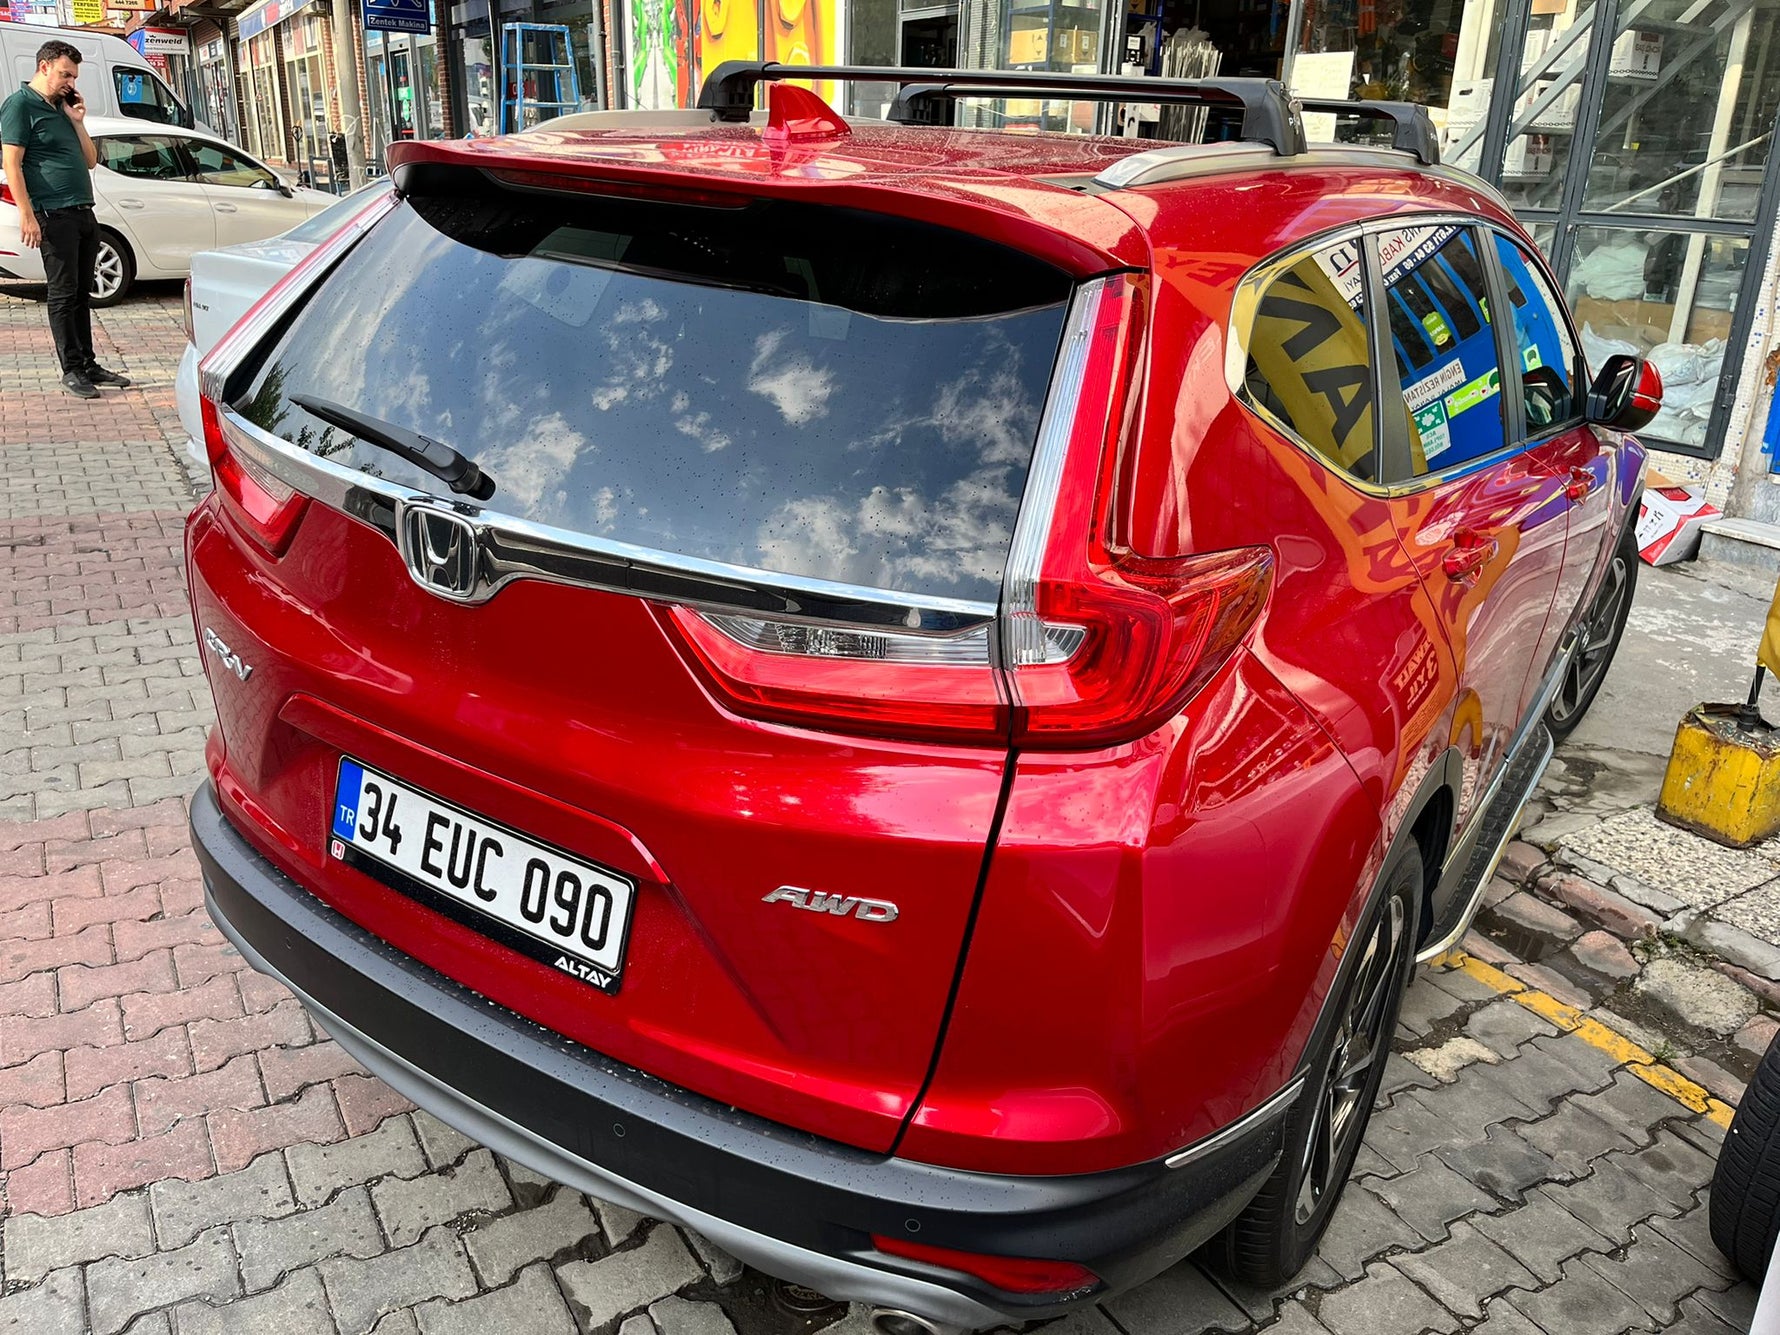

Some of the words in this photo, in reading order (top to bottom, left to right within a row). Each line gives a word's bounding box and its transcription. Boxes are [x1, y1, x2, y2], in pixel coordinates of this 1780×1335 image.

[370, 17, 396, 27] Zentek
[398, 20, 425, 29] Makina
[340, 805, 355, 827] TR
[359, 781, 402, 856] 34
[420, 810, 504, 903] EUC
[520, 857, 614, 952] 090
[761, 885, 900, 922] AWD
[553, 955, 613, 988] ALTAY
